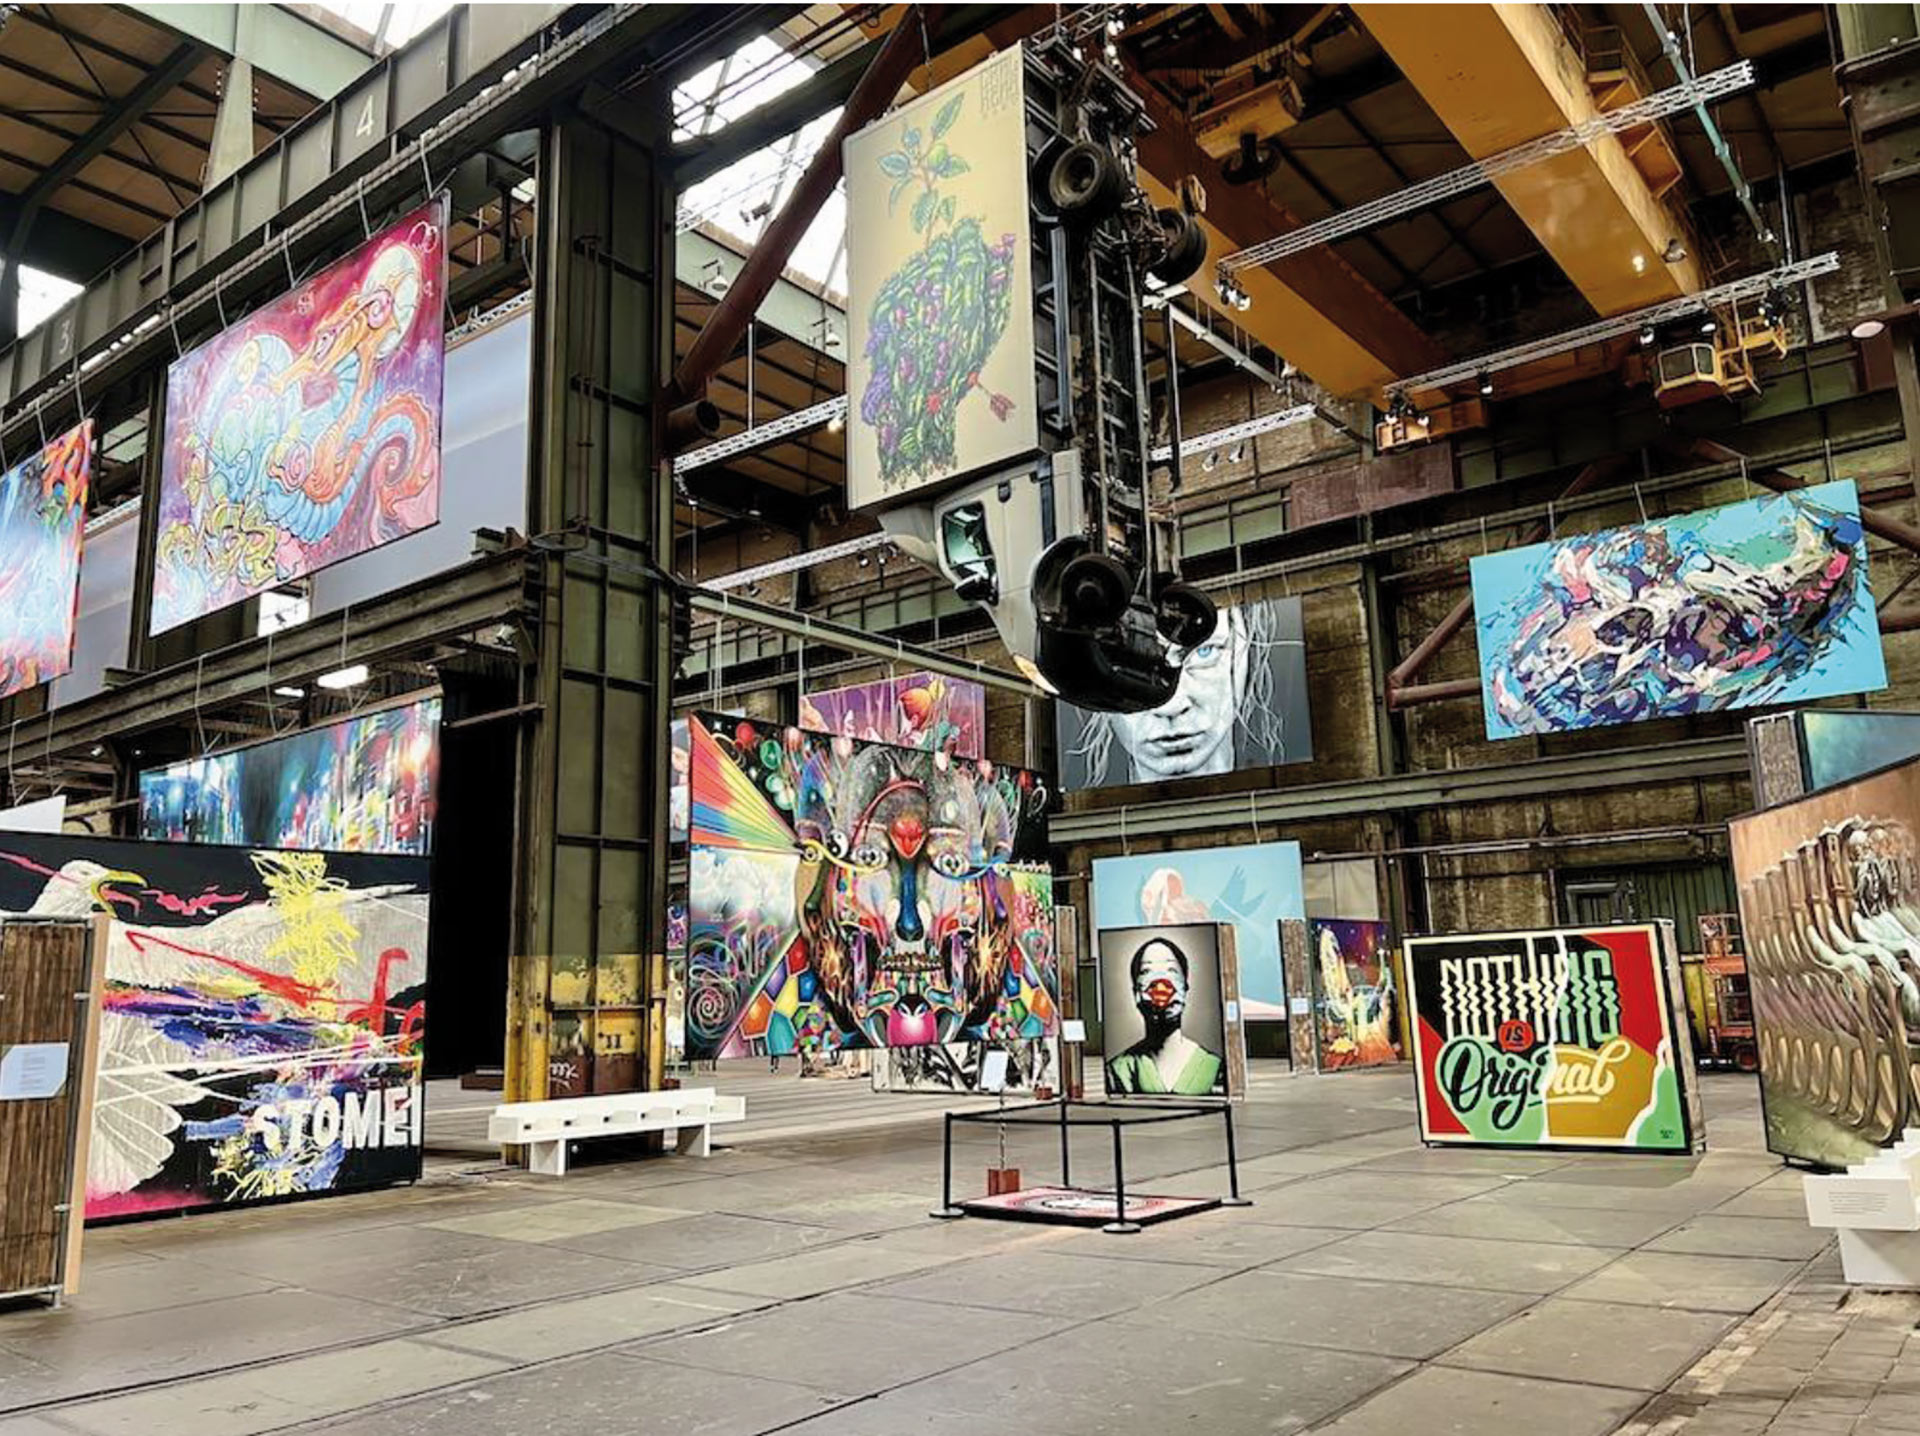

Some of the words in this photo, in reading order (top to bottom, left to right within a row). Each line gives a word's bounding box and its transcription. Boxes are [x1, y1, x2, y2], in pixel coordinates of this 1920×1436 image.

[356, 94, 374, 138] 4
[59, 319, 71, 354] 3
[1440, 942, 1624, 1047] NOTHING
[1506, 1026, 1524, 1041] IS
[1440, 1038, 1631, 1130] Original
